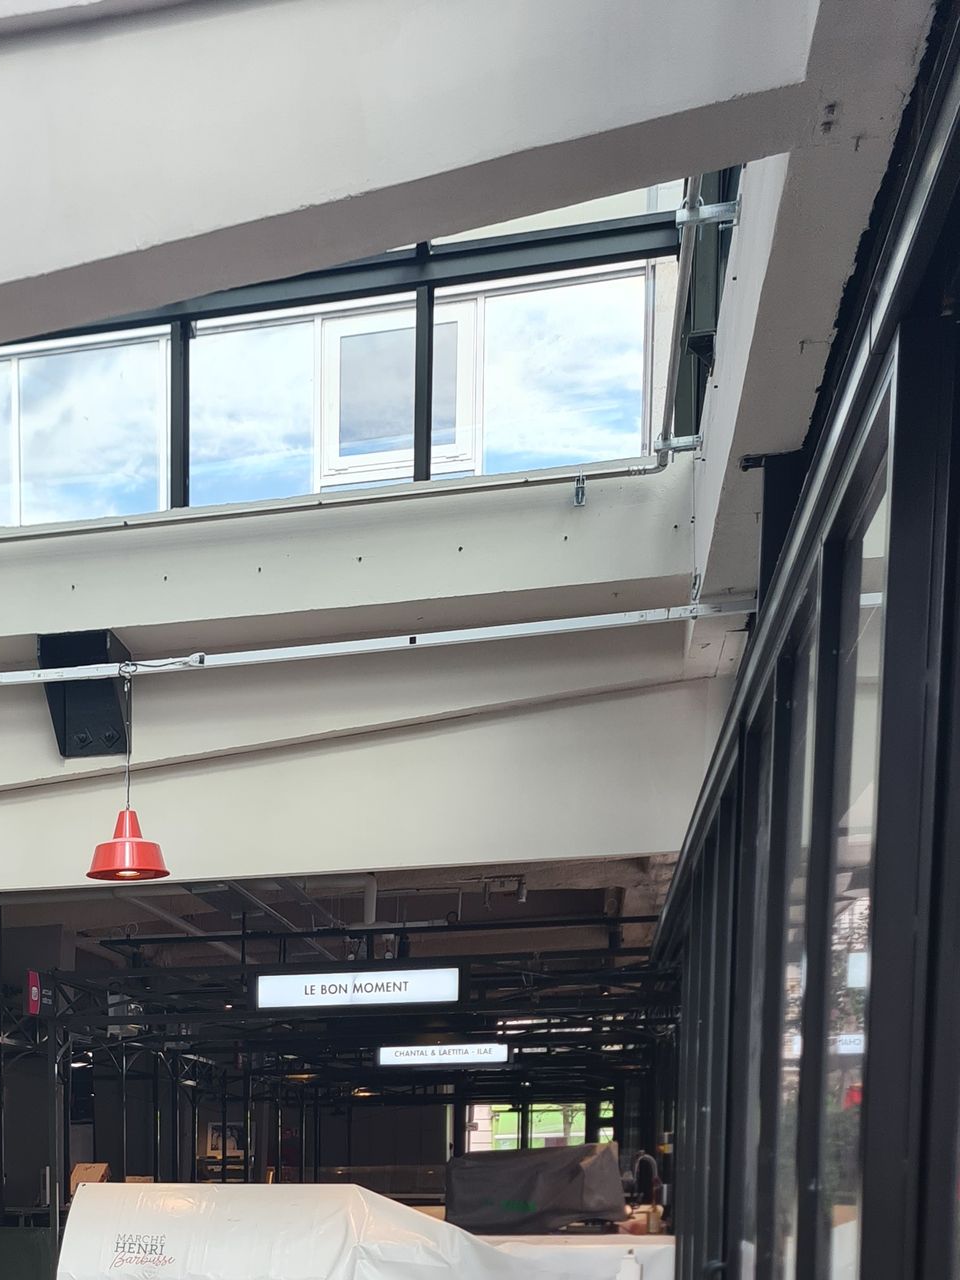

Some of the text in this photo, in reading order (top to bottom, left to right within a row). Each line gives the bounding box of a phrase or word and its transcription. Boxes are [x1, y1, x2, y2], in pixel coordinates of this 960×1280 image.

[304, 981, 409, 996] LE BON MOMENT
[439, 1048, 470, 1056] LAETITIA
[116, 1233, 167, 1245] MARCHÉ
[114, 1242, 165, 1256] HENRI
[109, 1251, 176, 1270] Barbusse
